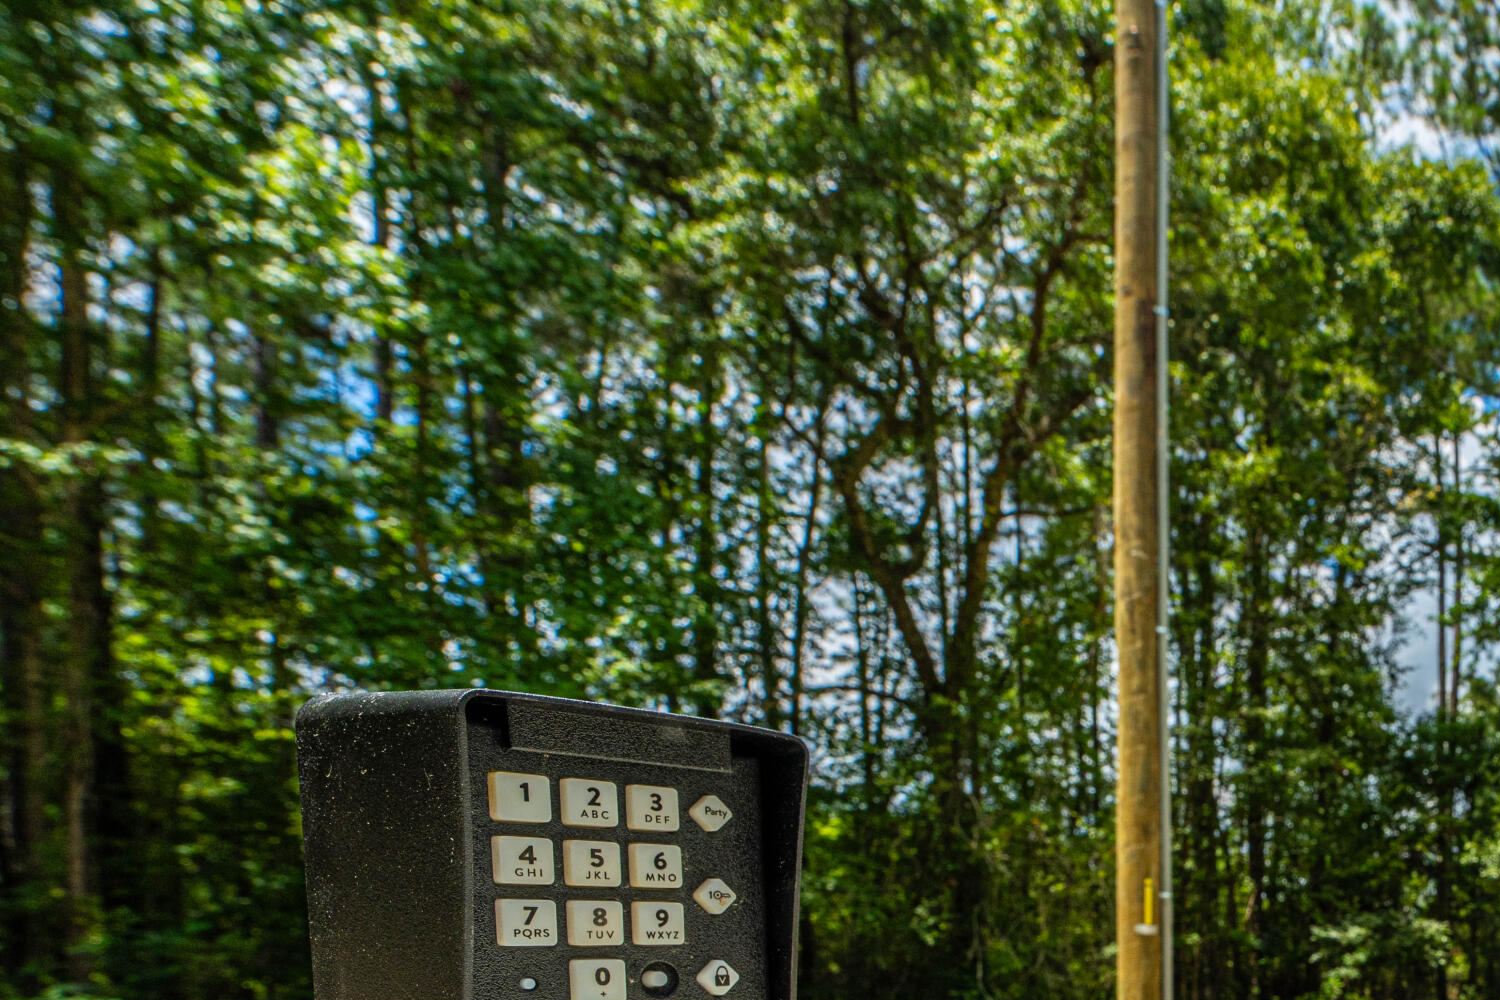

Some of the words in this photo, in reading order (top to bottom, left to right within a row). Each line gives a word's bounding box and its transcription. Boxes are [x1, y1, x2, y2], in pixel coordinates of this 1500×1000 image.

[520, 782, 529, 802] 1
[587, 788, 601, 806] 2
[650, 794, 662, 811] 3
[581, 810, 609, 820] ABC
[645, 815, 670, 824] DEF
[705, 806, 728, 818] Party
[518, 845, 537, 864] 4
[590, 849, 604, 867] 5
[654, 852, 667, 870] 6
[515, 868, 542, 877] GHI
[586, 871, 610, 880] JKL
[646, 874, 676, 882] MNO
[522, 907, 538, 925] 7
[592, 908, 607, 926] 8
[656, 910, 668, 927] 9
[514, 928, 550, 939] PQRS
[587, 930, 614, 939] TUV
[646, 931, 679, 940] WXYZ
[595, 967, 610, 986] 0
